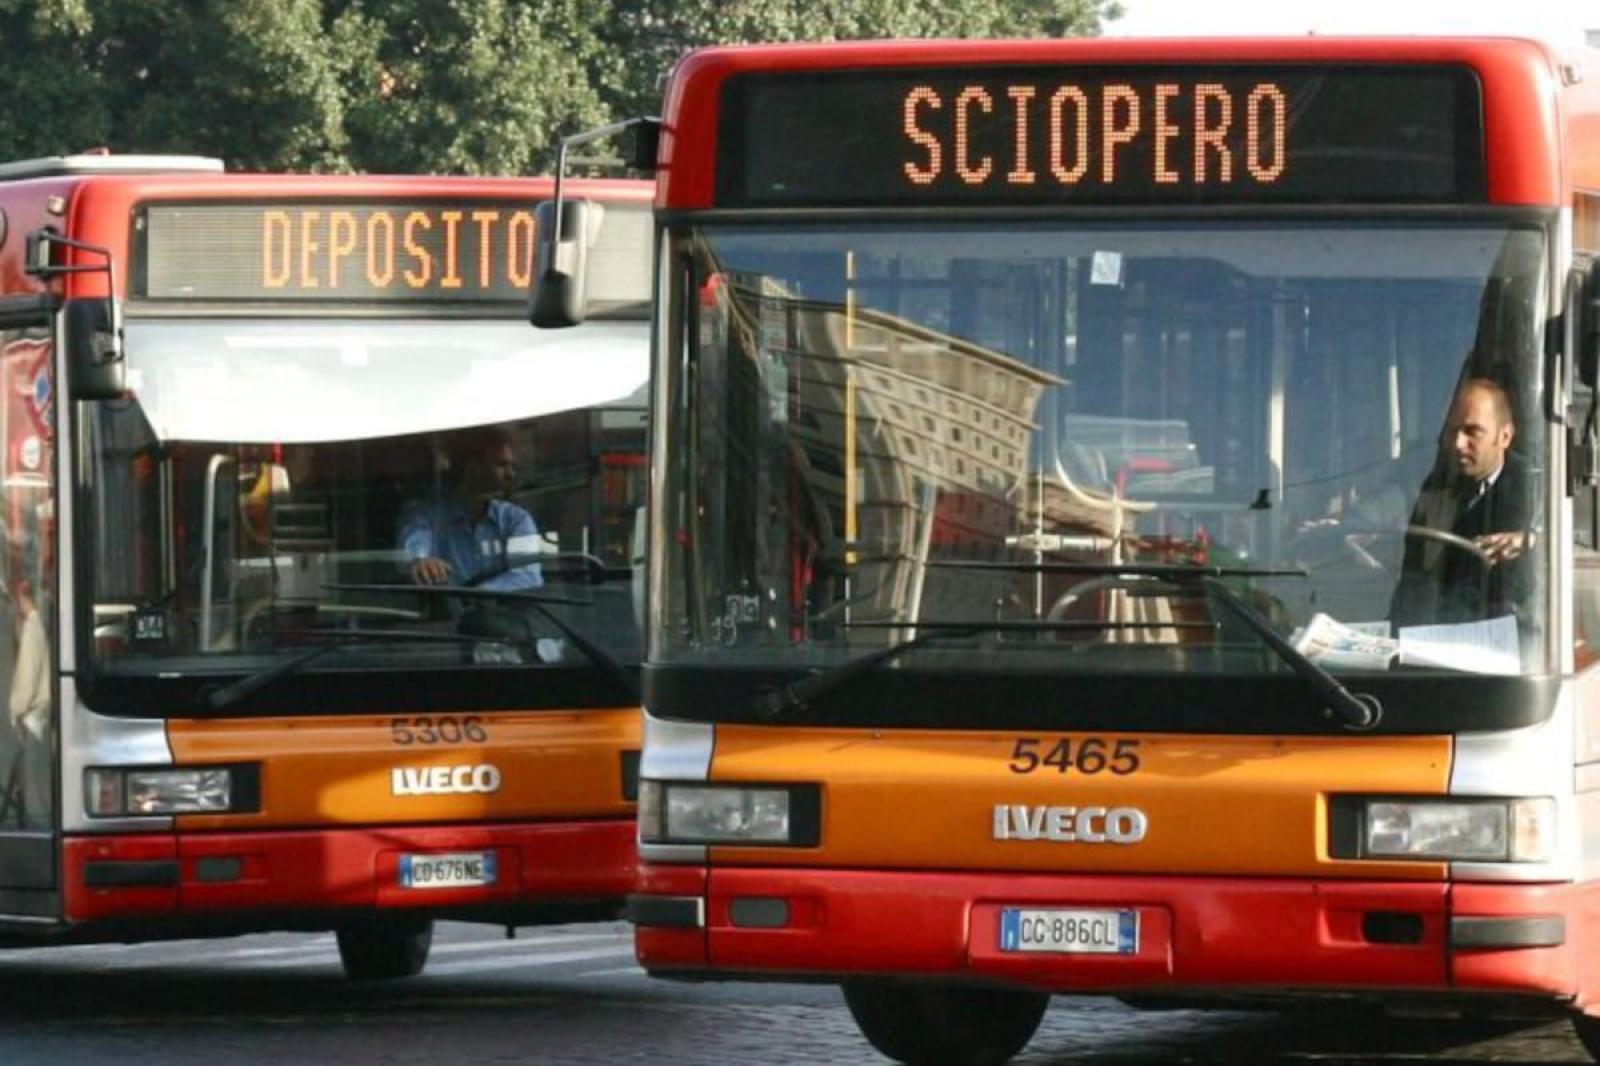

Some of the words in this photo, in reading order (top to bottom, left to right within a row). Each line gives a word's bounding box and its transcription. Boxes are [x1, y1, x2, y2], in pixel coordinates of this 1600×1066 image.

[904, 84, 1286, 183] SCIOPERO
[262, 211, 536, 288] DEPOSITO
[391, 716, 487, 745] 5306
[1009, 738, 1140, 775] 5465
[392, 764, 501, 796] IVECO
[993, 804, 1148, 843] IVECO
